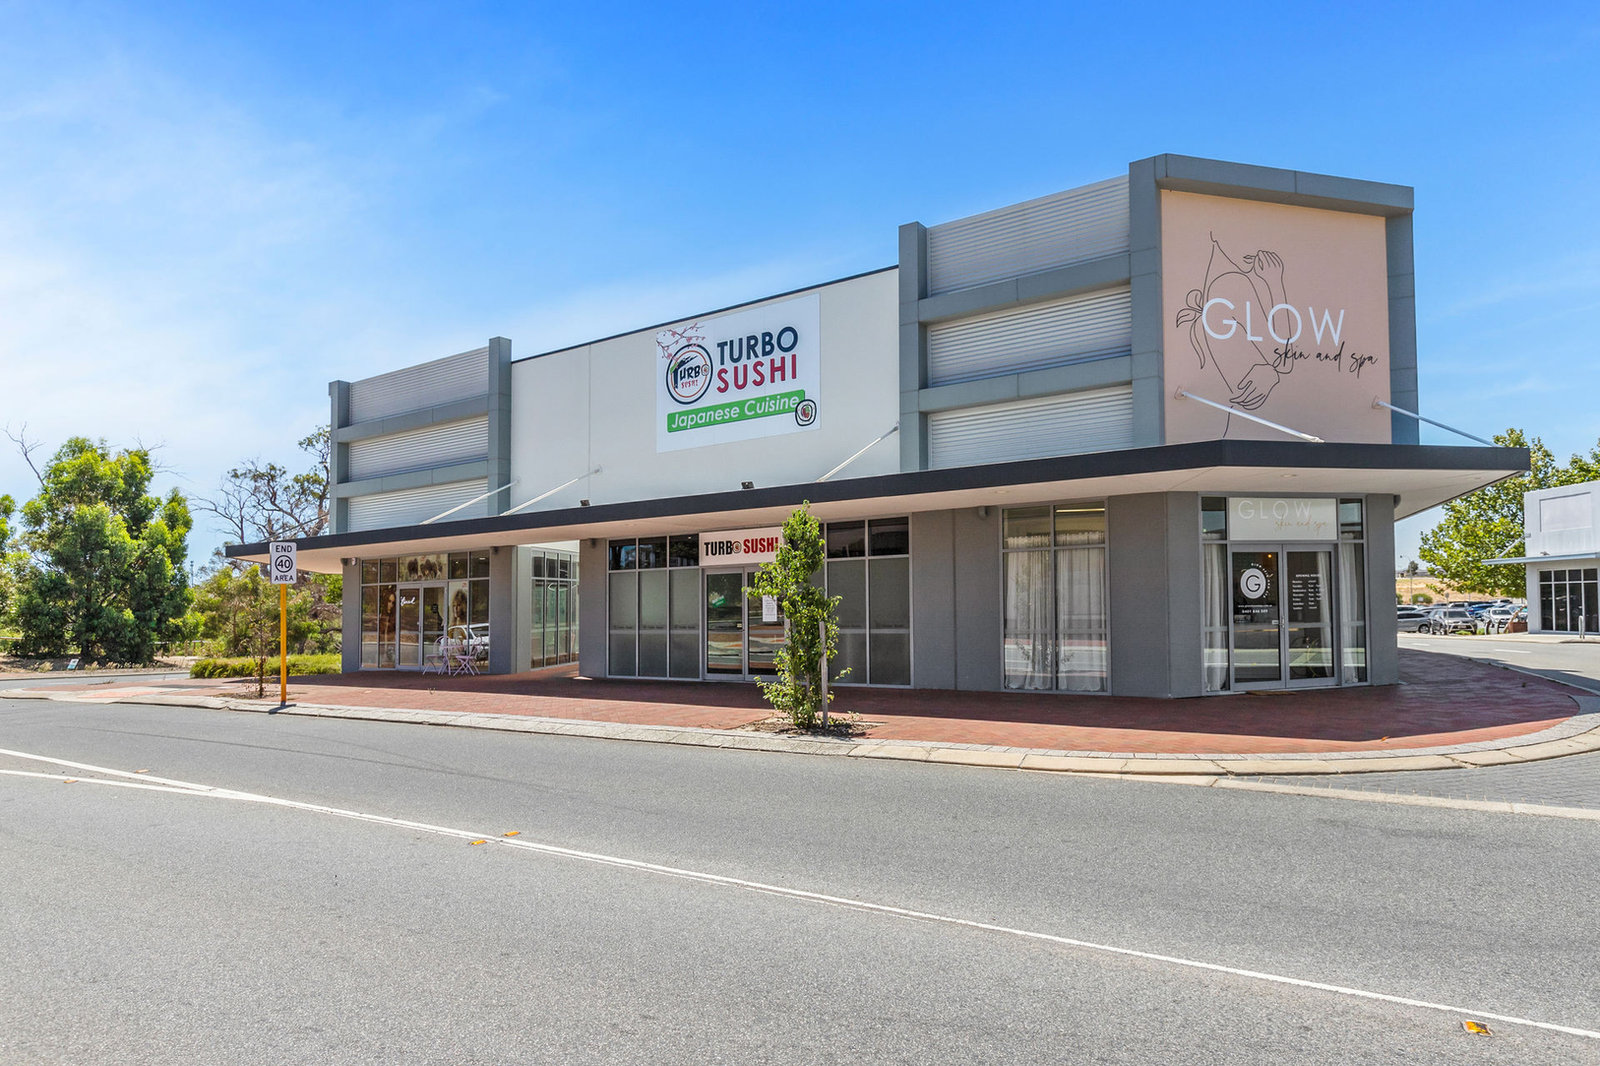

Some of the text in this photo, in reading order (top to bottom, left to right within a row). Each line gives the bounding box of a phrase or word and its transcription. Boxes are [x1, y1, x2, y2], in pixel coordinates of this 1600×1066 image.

[1201, 297, 1345, 346] GLOW
[717, 326, 799, 365] TURBO
[1273, 338, 1378, 379] skin and spa
[716, 354, 798, 393] SUSHI
[671, 394, 800, 429] Japanese Cuisine
[1238, 500, 1311, 519] GLOW
[276, 545, 292, 553] END
[743, 537, 779, 554] SUSHI
[278, 560, 290, 569] 40
[1245, 574, 1261, 592] G
